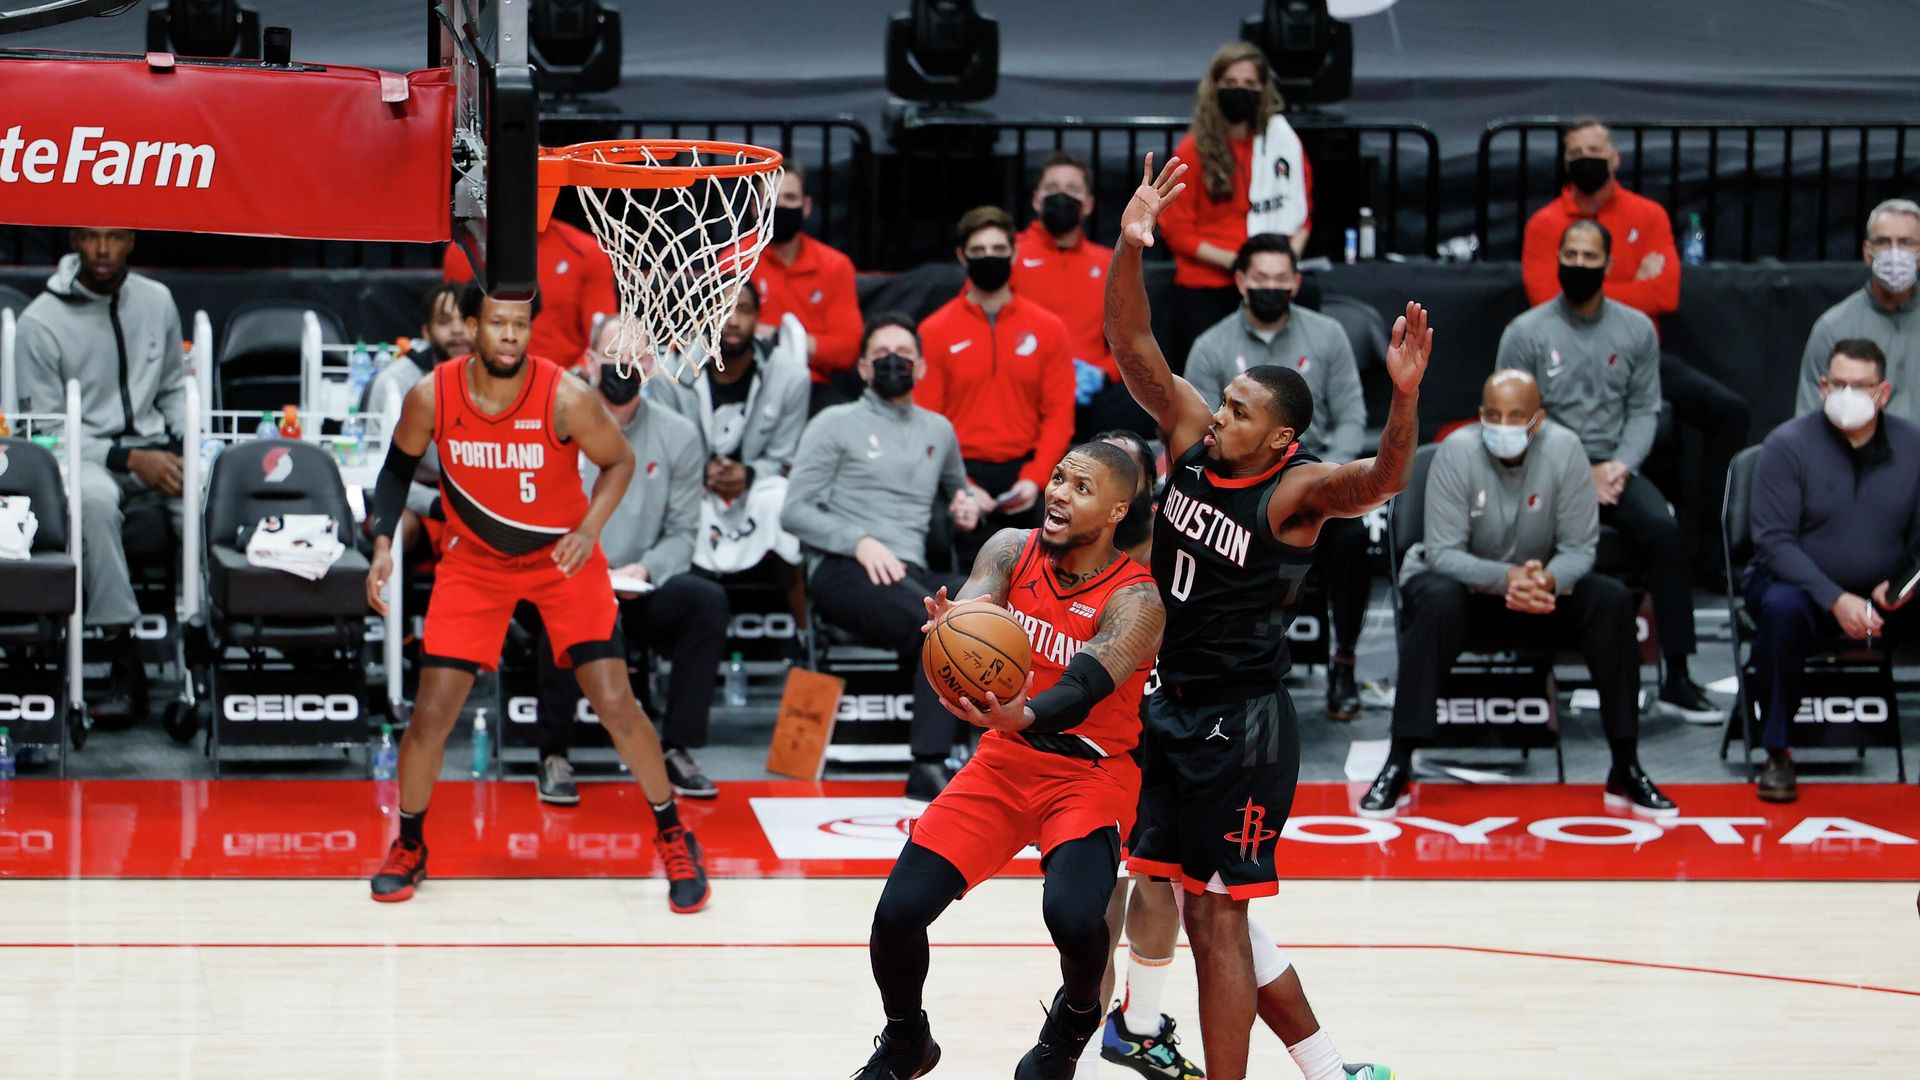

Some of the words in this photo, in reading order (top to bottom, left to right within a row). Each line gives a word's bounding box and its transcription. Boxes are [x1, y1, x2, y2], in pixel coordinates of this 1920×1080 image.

[62, 126, 216, 188] Farm
[448, 439, 544, 469] PORTLAND
[519, 472, 537, 503] 5
[1163, 483, 1251, 568] HOUSTON
[1171, 549, 1196, 602] 0
[726, 613, 796, 638] ICO
[1006, 600, 1088, 667] ORTLAN
[223, 694, 358, 721] GEICO
[837, 694, 915, 721] GEIC
[1793, 696, 1889, 723] EICO
[1281, 816, 1919, 845] OYOTA
